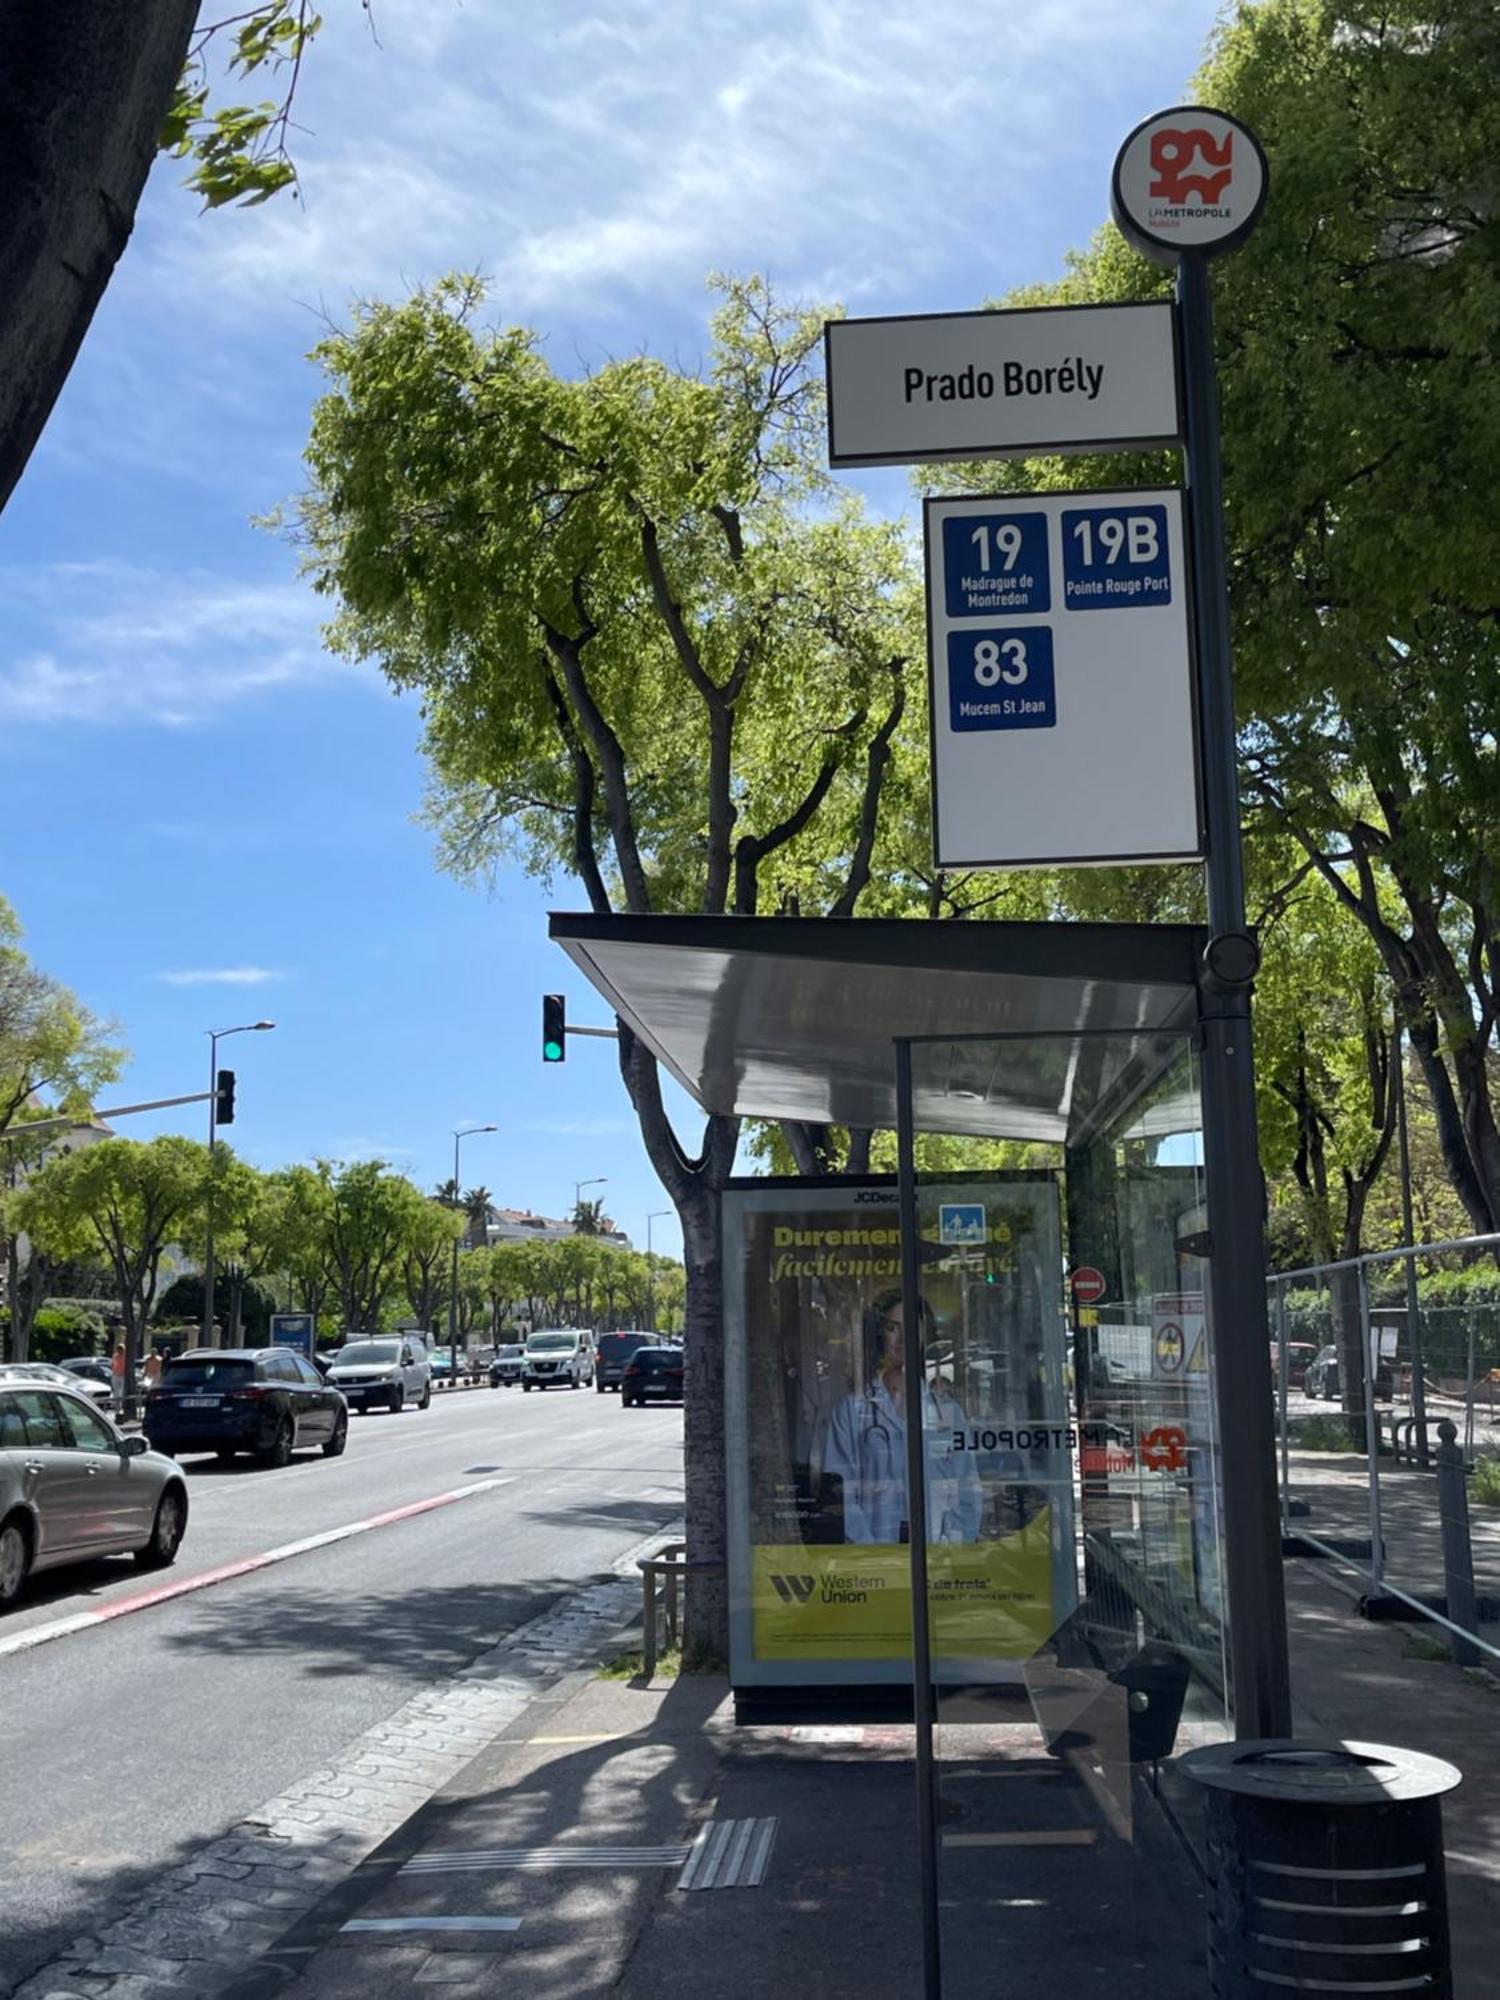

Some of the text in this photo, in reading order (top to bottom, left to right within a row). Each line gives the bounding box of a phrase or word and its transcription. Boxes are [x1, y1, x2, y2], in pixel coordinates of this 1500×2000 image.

[904, 357, 1104, 403] Prado Borély
[971, 524, 1022, 573] 19
[1073, 516, 1159, 566] 19B
[961, 574, 1034, 592] Madrague de
[1066, 576, 1169, 596] Pointe Rouge Port
[967, 592, 1028, 609] Montredon
[973, 638, 1028, 687] 83
[959, 699, 1046, 717] Mucem St Jean
[773, 1226, 902, 1247] Duremen
[773, 1252, 903, 1282] facilemen
[819, 1574, 885, 1589] Western
[820, 1590, 867, 1604] Union
